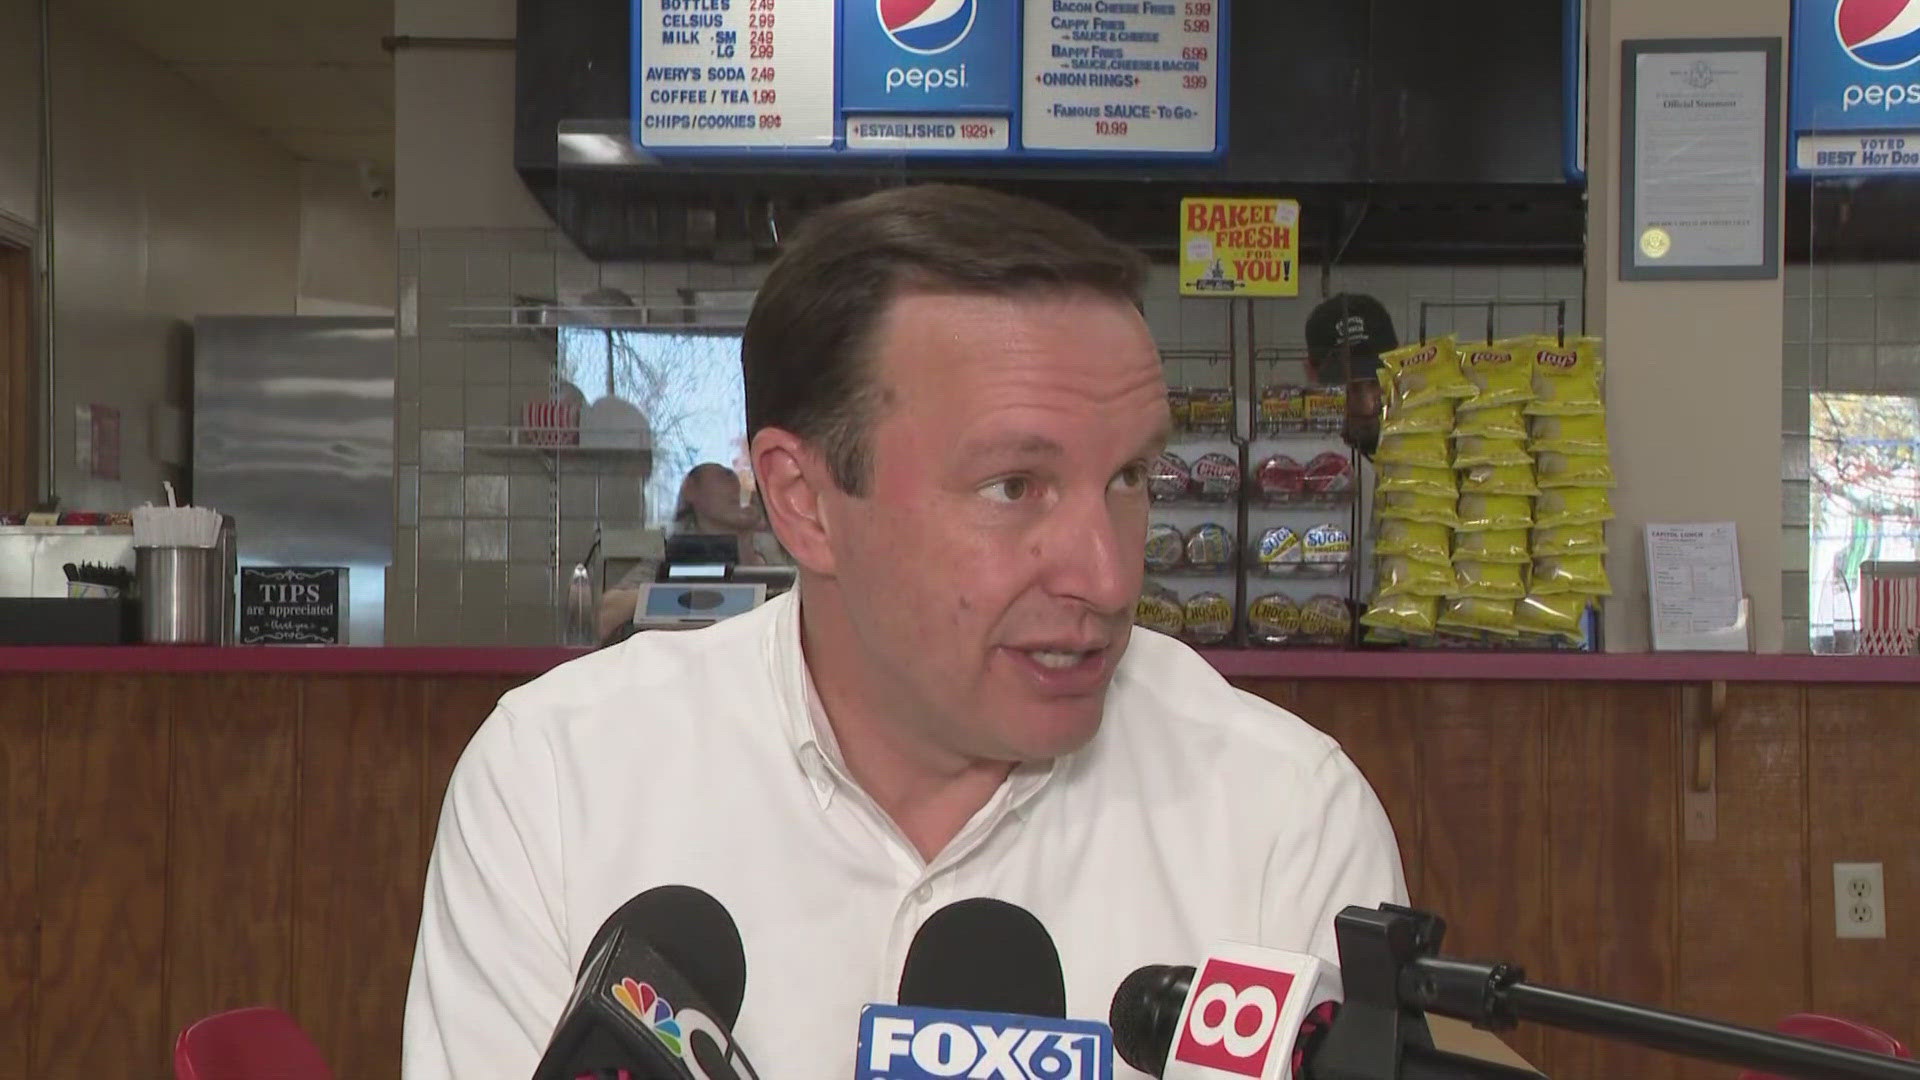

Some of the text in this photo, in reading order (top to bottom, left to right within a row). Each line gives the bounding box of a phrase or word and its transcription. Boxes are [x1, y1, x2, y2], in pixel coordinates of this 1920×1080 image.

[661, 0, 730, 10] BOTTLES
[1185, 2, 1210, 16] 5.99
[662, 14, 775, 28] CELSIUS 2.99
[1184, 19, 1209, 33] 5.99
[662, 31, 774, 45] MILK SM 2.49
[1072, 31, 1159, 43] SAUCE & CHEESE
[717, 45, 774, 59] LG 2.99
[1182, 47, 1207, 61] 6.99
[646, 67, 775, 82] AVERY'S SODA 2.49
[886, 63, 966, 94] pepsi
[1043, 73, 1208, 89] ONION RINGS 3.99
[650, 90, 706, 104] COFFEE
[721, 90, 749, 103] TEA
[753, 90, 776, 104] 1.99
[1104, 105, 1150, 119] SAUCE
[860, 124, 987, 139] ESTABLISHED 1929
[1096, 121, 1128, 136] 10.99
[1860, 139, 1905, 149] VOTED
[1817, 151, 1856, 166] BEST
[1216, 226, 1290, 249] FRESH
[1246, 250, 1272, 259] FOR
[1234, 259, 1291, 282] YOU!
[260, 584, 320, 603] TIPS
[246, 603, 334, 618] are appreciated
[1190, 983, 1277, 1058] 8
